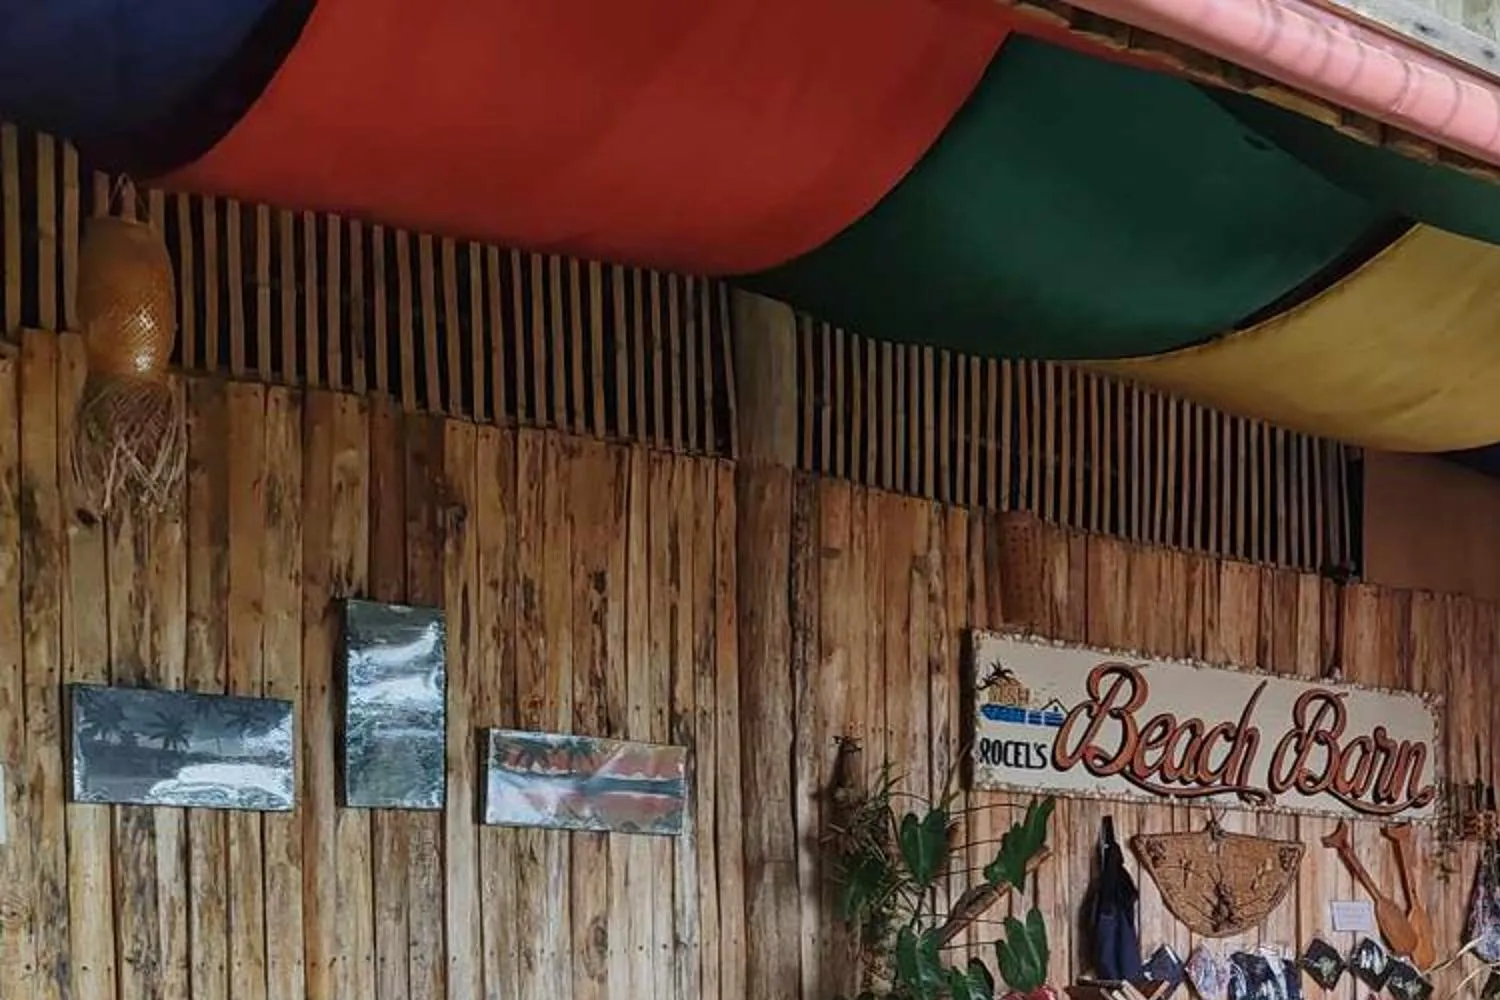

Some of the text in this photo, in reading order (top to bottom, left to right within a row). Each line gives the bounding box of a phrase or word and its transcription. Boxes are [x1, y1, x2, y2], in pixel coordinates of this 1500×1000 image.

[979, 737, 1048, 770] ROCEL'S
[1053, 663, 1434, 813] Beach Barn
